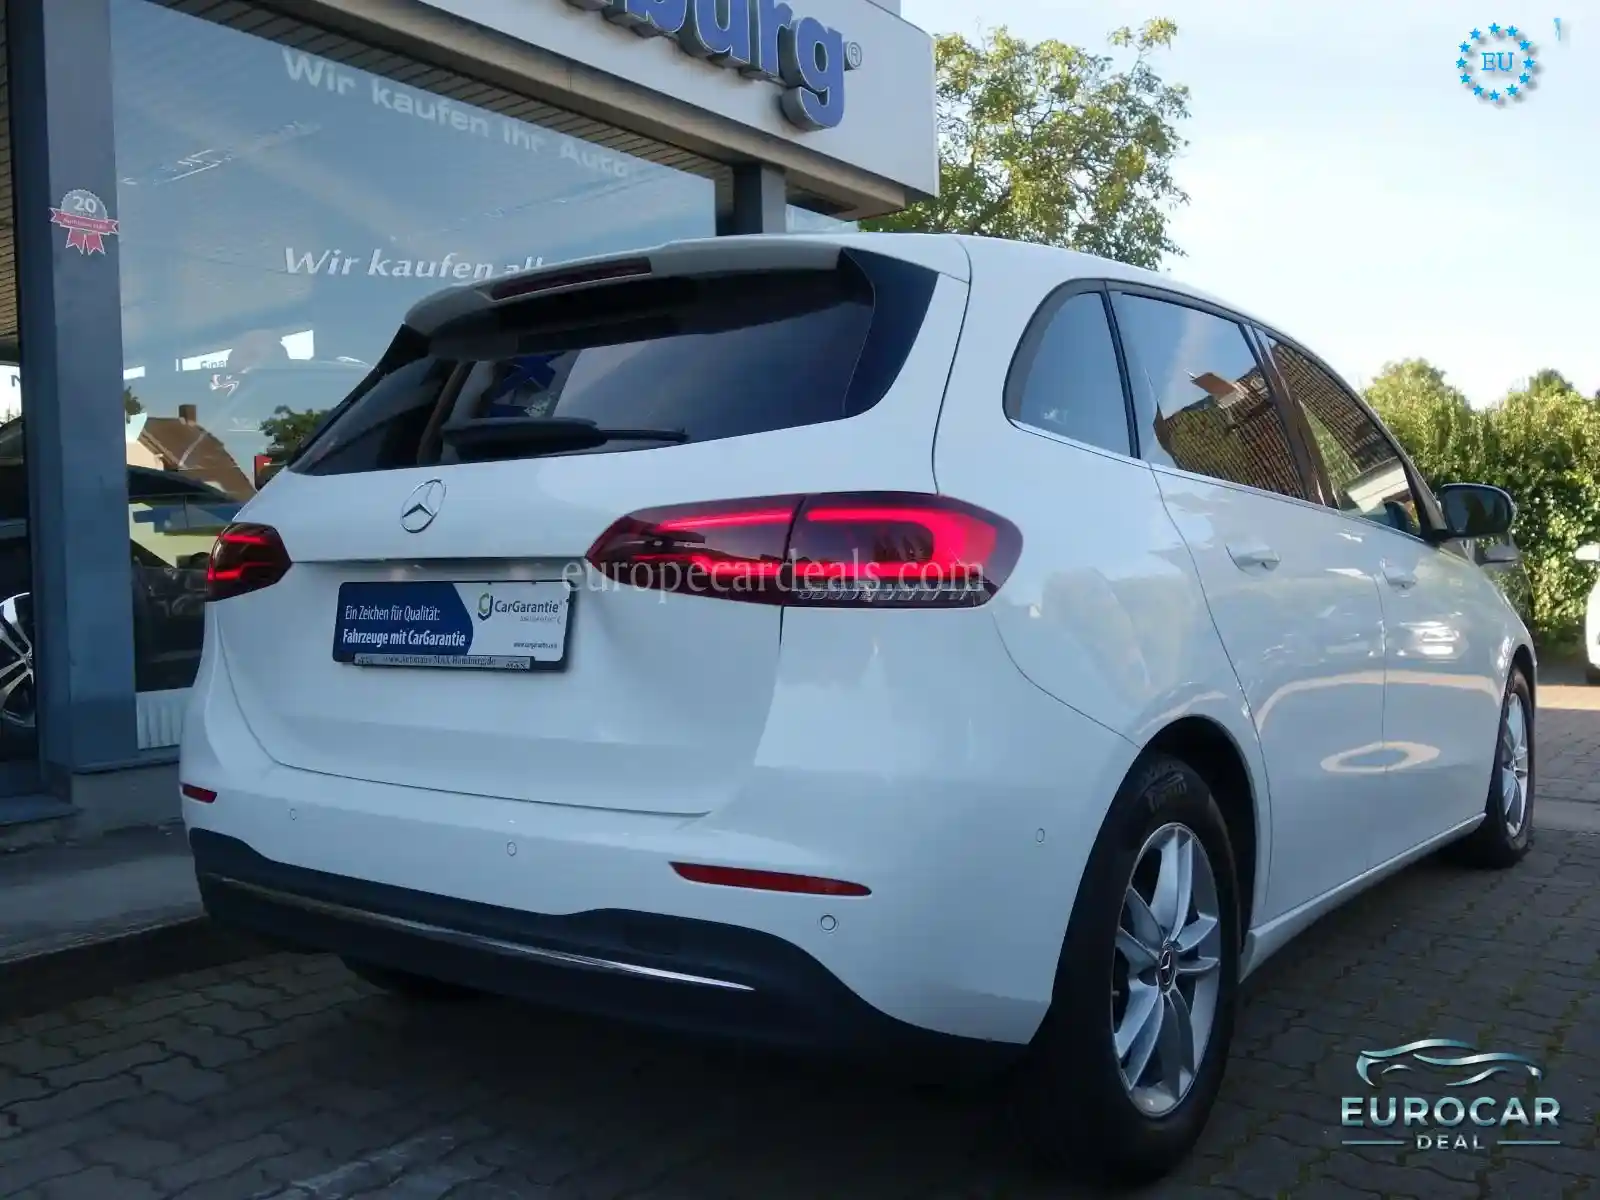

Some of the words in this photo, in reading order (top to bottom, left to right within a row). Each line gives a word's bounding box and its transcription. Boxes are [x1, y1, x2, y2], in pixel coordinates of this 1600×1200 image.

[282, 45, 356, 95] Wir
[371, 77, 489, 134] kaufen
[73, 196, 97, 214] 20
[284, 247, 361, 275] Wir
[367, 248, 493, 279] kaufen
[345, 605, 357, 620] Ein
[359, 605, 389, 620] Zeichen
[391, 605, 402, 620] für
[404, 605, 441, 623] Qualität:
[343, 628, 388, 648] Fahrzeuge
[390, 629, 406, 645] mit
[408, 629, 467, 647] CarGarantie
